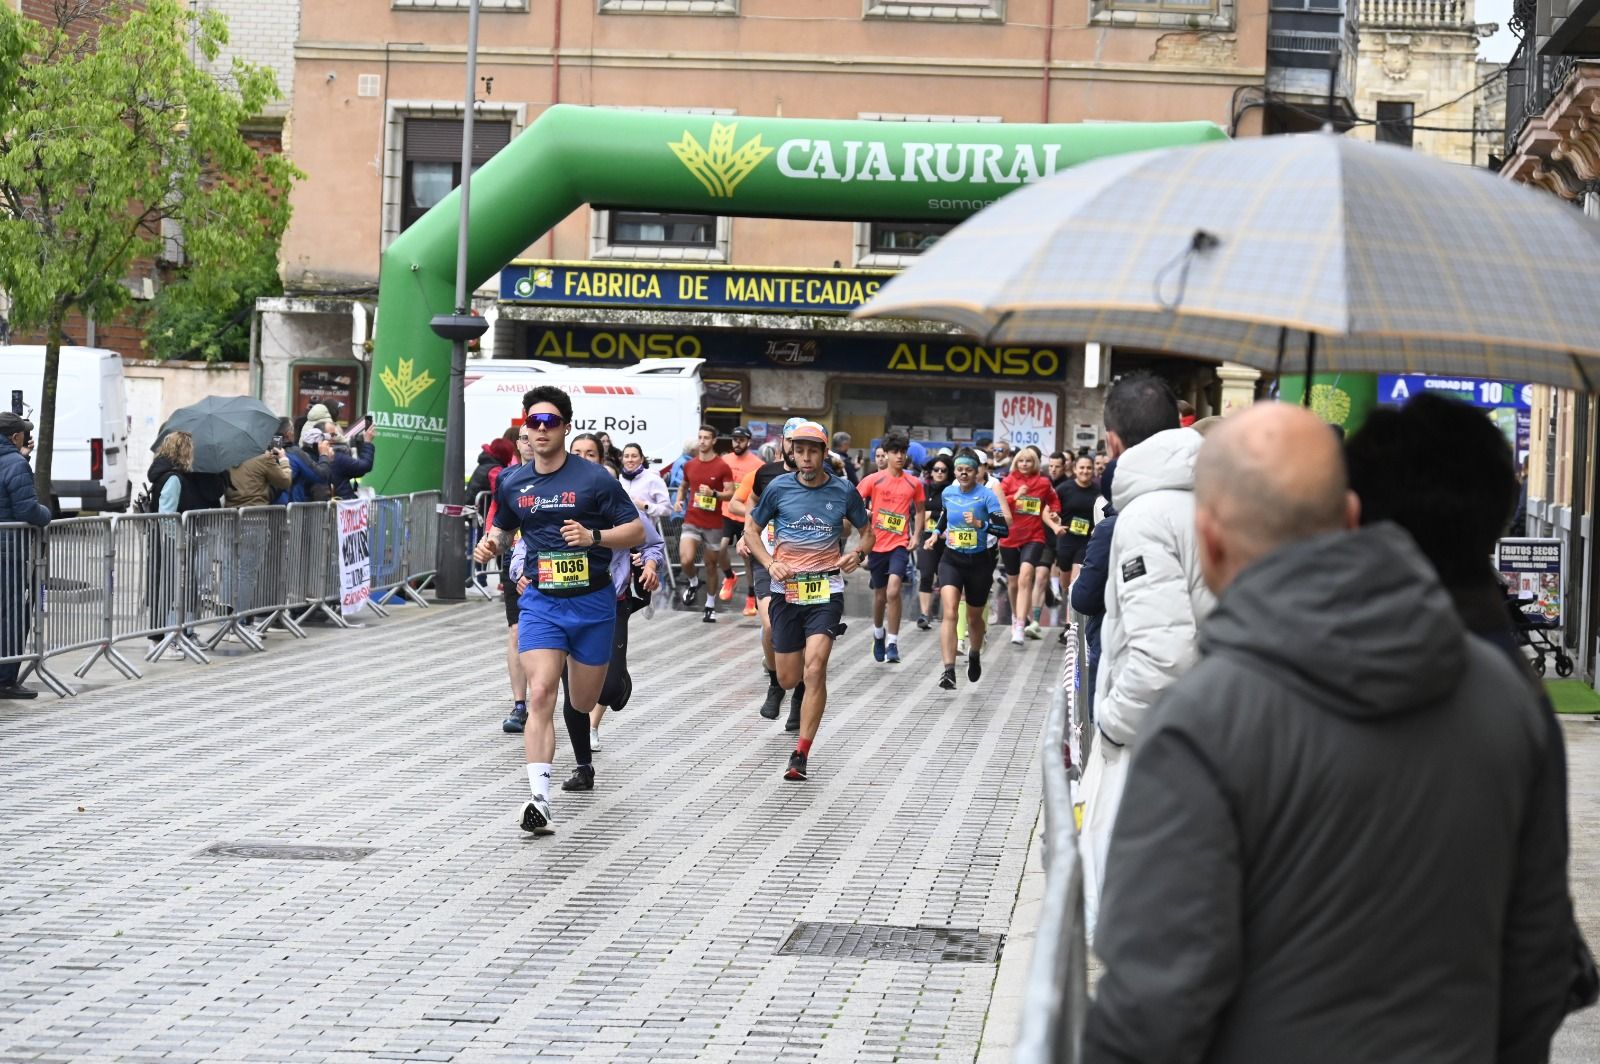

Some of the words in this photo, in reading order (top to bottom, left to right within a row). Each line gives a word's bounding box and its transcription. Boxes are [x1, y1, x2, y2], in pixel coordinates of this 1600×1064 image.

[776, 138, 897, 183] CAJA
[901, 142, 1062, 184] RURAL
[564, 270, 662, 299] FABRICA
[679, 274, 710, 300] DE
[725, 277, 880, 305] MANTECADAS
[534, 330, 702, 360] ALONSO
[887, 342, 1060, 377] ALONSO
[1479, 381, 1515, 404] 10K
[1002, 395, 1054, 428] OFERTA
[392, 412, 447, 432] RURAL
[604, 414, 648, 434] Roja
[887, 516, 902, 526] 630
[958, 532, 972, 541] 821
[1501, 545, 1532, 555] FRUTOS
[1532, 546, 1559, 556] SECOS
[555, 559, 585, 573] 1036
[804, 581, 822, 594] 707
